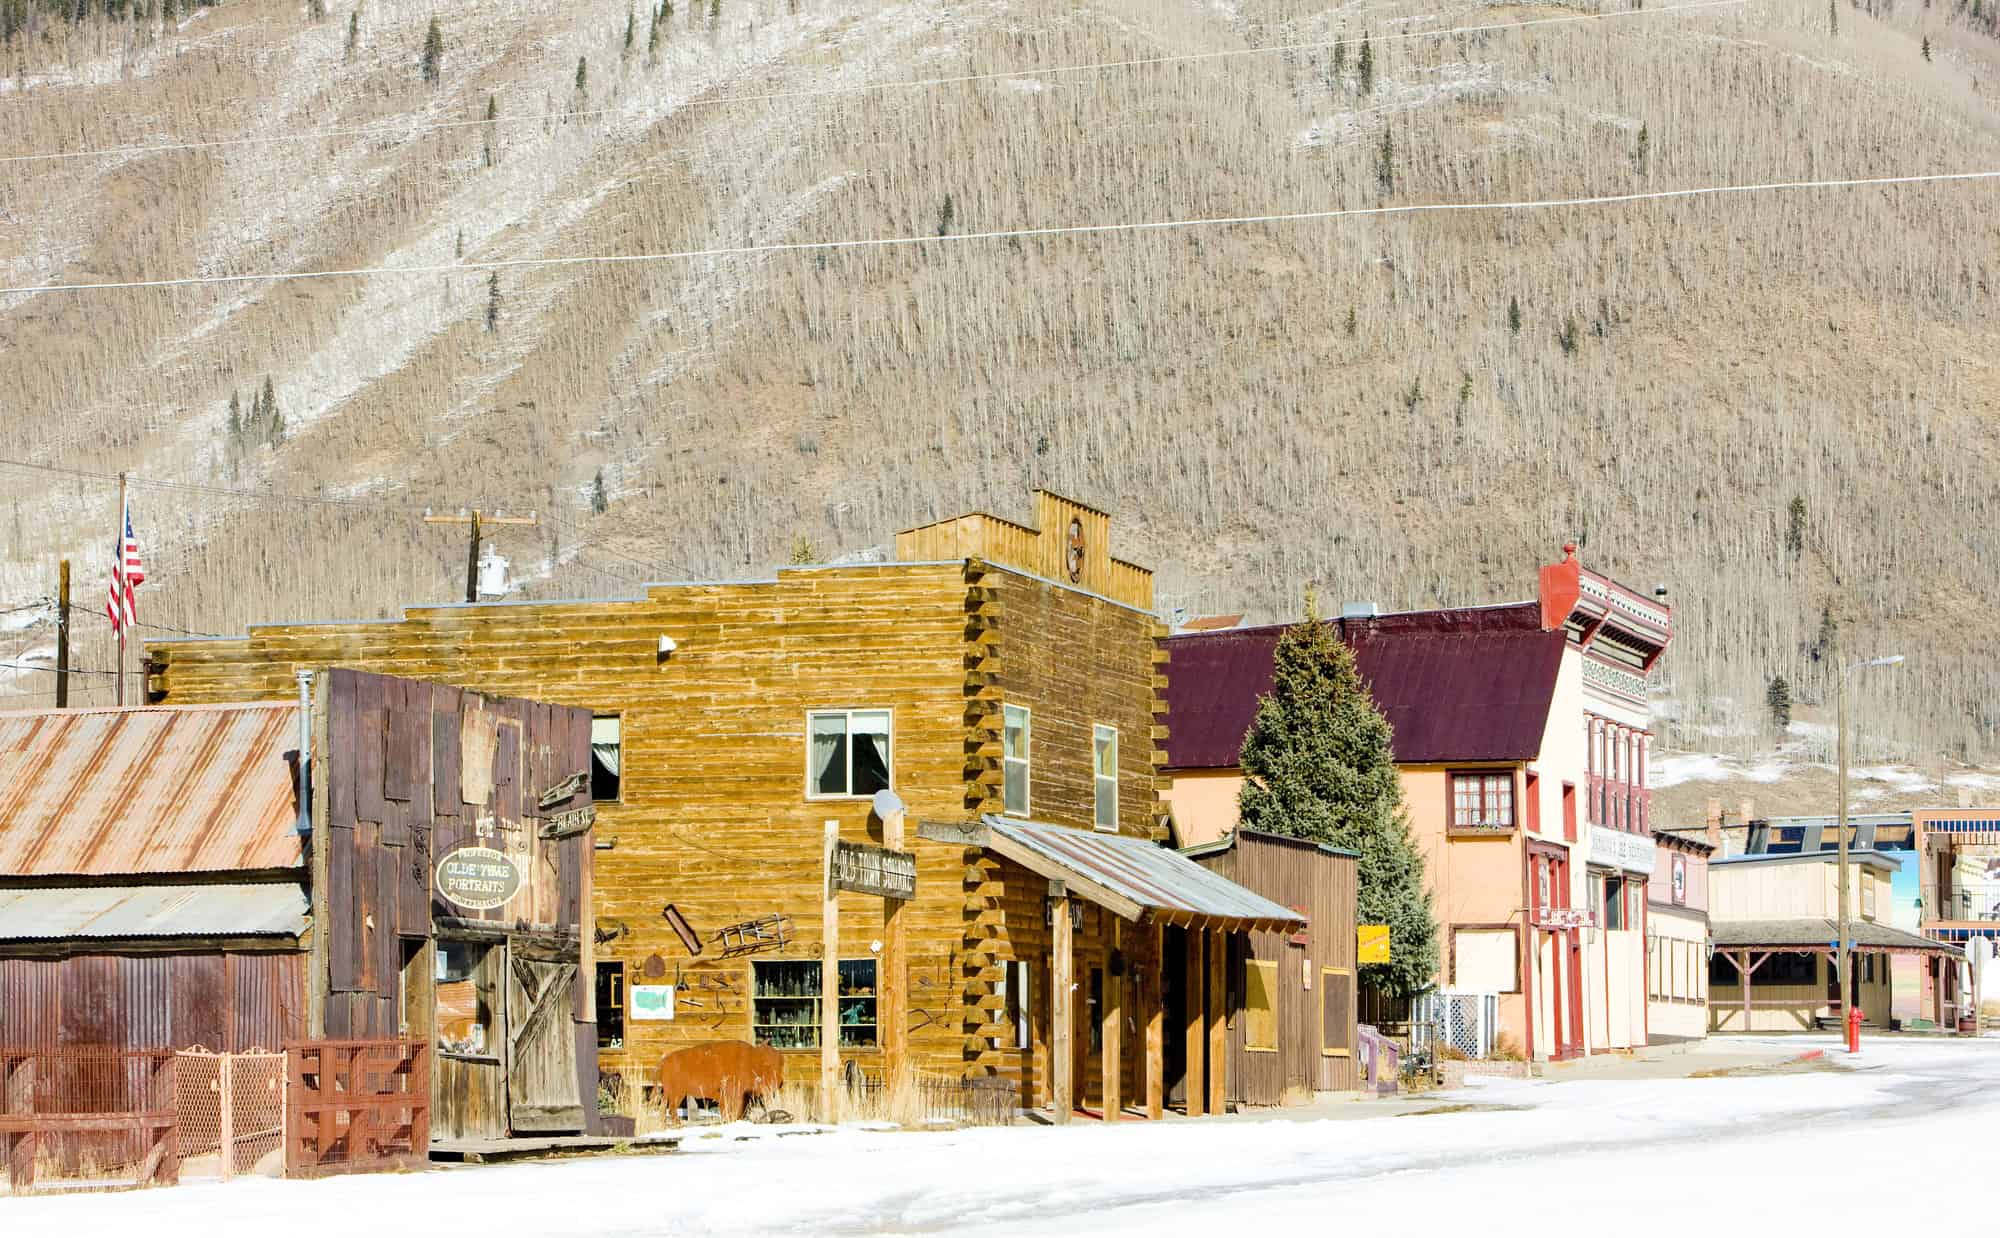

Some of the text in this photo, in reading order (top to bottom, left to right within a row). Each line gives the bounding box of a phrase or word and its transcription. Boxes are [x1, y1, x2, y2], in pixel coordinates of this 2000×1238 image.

[447, 862, 476, 876] OLDE
[840, 849, 913, 892] OLD TOWN SQUARE
[448, 878, 505, 893] PORTRAITS
